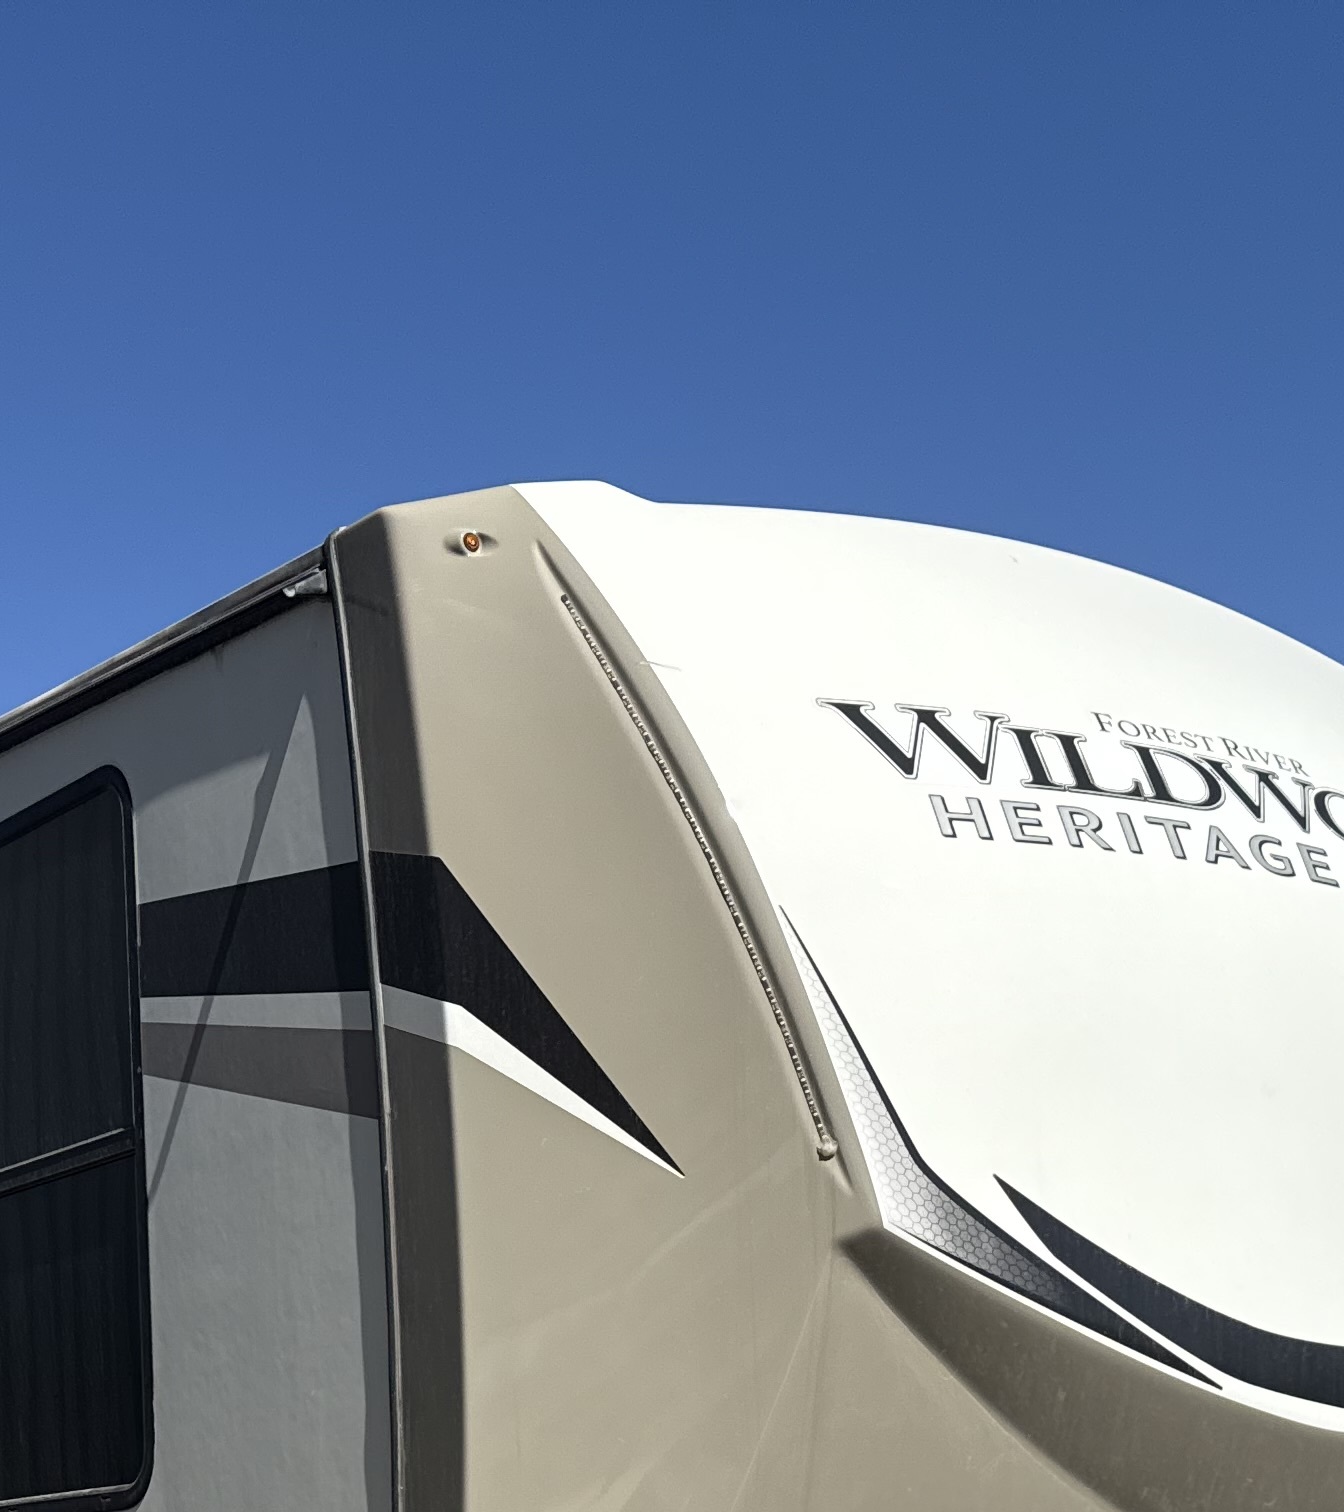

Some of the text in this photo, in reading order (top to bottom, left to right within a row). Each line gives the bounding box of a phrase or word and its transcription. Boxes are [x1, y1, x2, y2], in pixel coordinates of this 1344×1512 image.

[1090, 711, 1311, 777] FOREST RIVER
[928, 793, 1341, 888] HERITAGE
